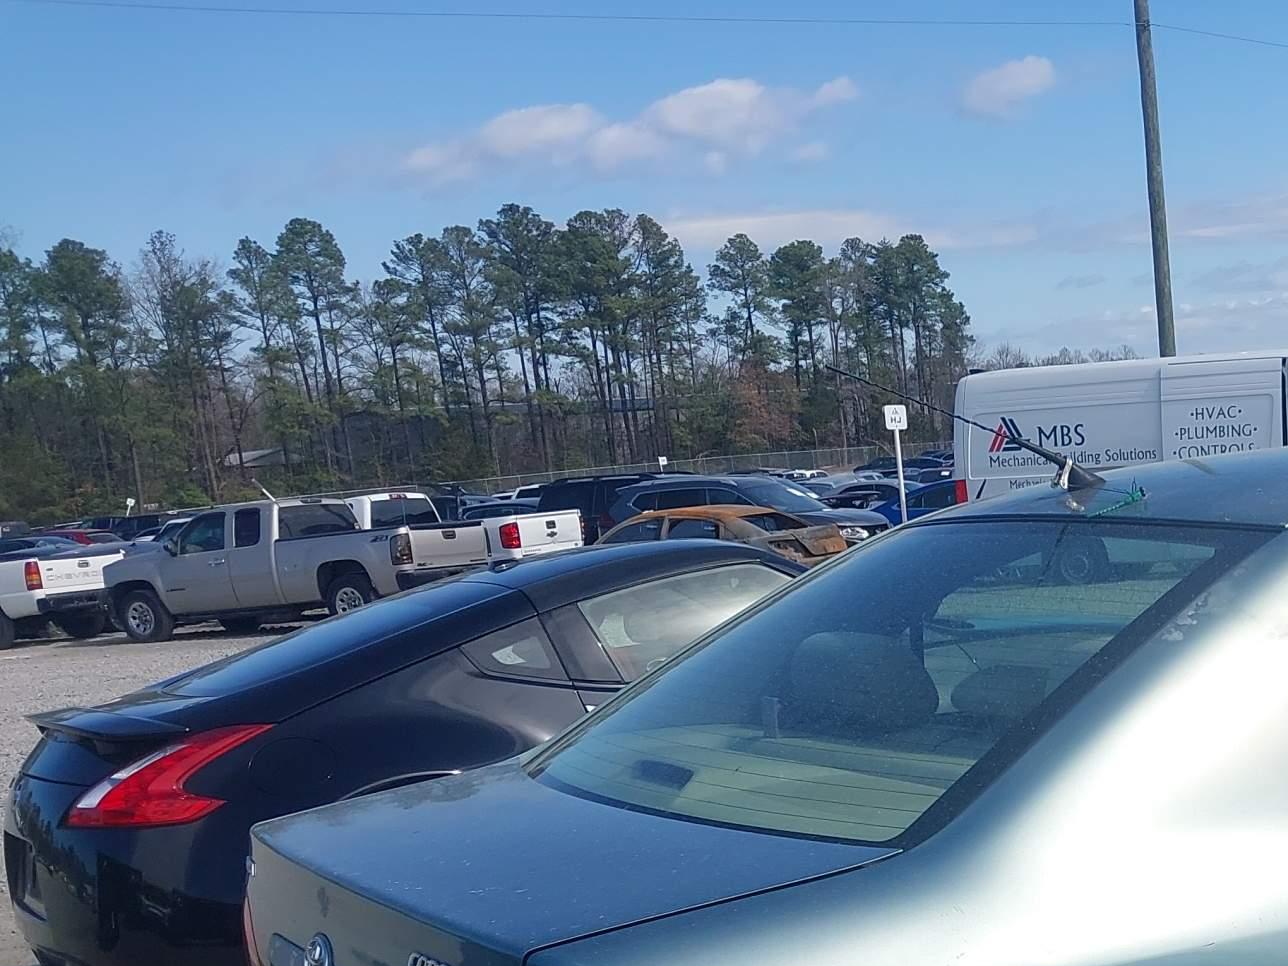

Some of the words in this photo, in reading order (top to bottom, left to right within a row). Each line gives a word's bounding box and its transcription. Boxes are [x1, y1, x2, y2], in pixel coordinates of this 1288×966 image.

[1195, 405, 1237, 420] HVAC
[1037, 424, 1086, 448] MBS
[1179, 424, 1252, 440] PLUMBING
[989, 452, 1052, 468] Mechanica
[1055, 450, 1102, 465] ilding
[1105, 448, 1157, 462] Solutions
[45, 570, 100, 581] CHEVRO
